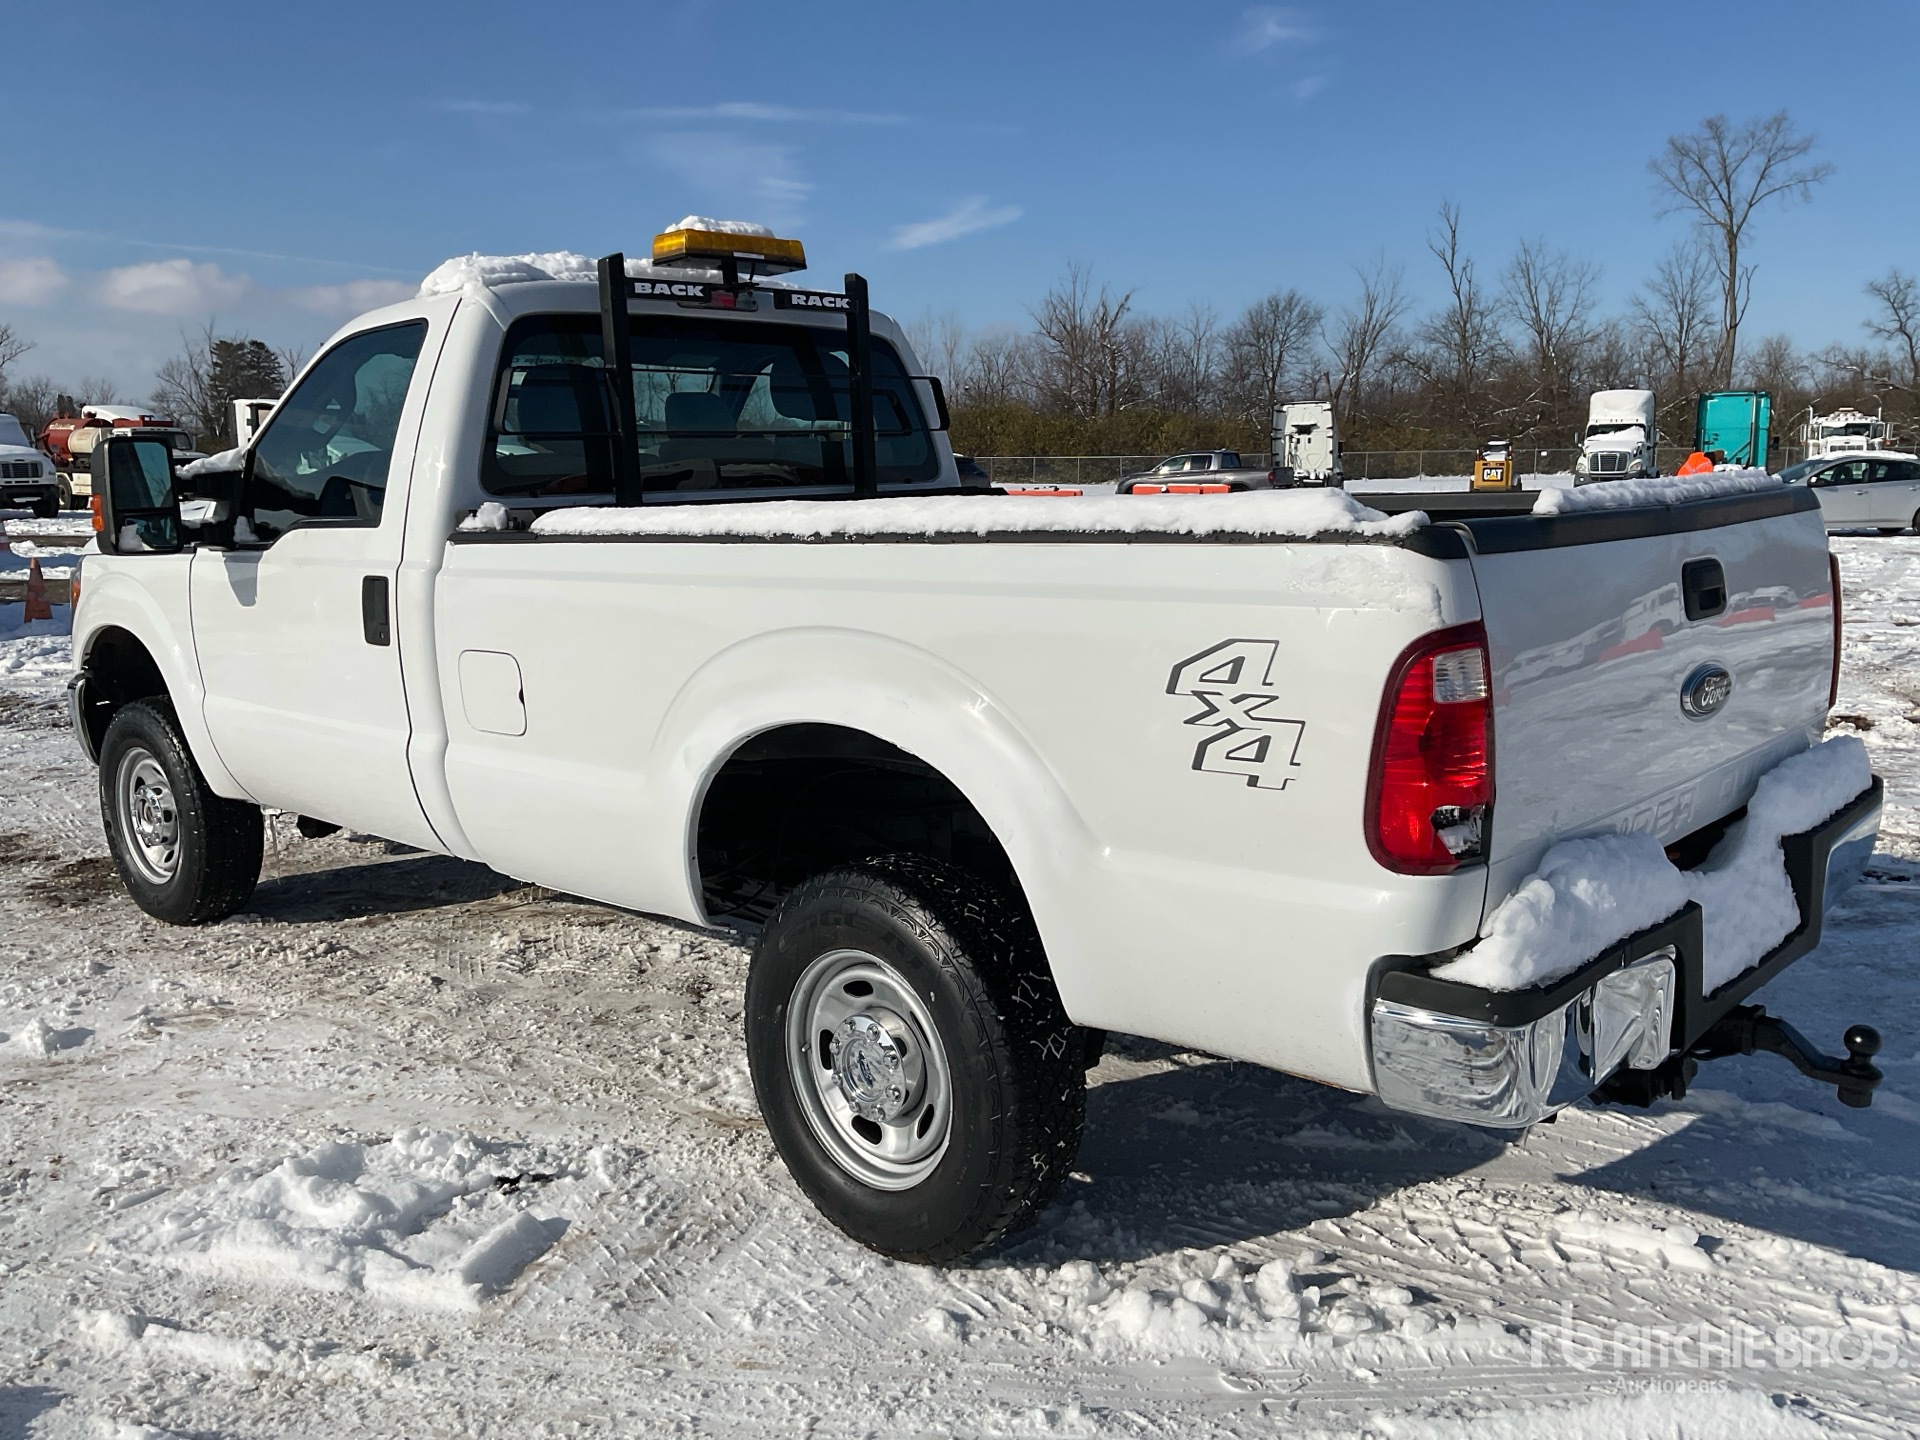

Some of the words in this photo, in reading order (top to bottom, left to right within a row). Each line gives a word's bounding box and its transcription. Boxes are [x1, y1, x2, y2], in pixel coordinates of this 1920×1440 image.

[633, 281, 705, 298] BACK
[790, 292, 851, 309] RACK
[1483, 468, 1503, 481] CAT
[1701, 676, 1728, 707] Ford
